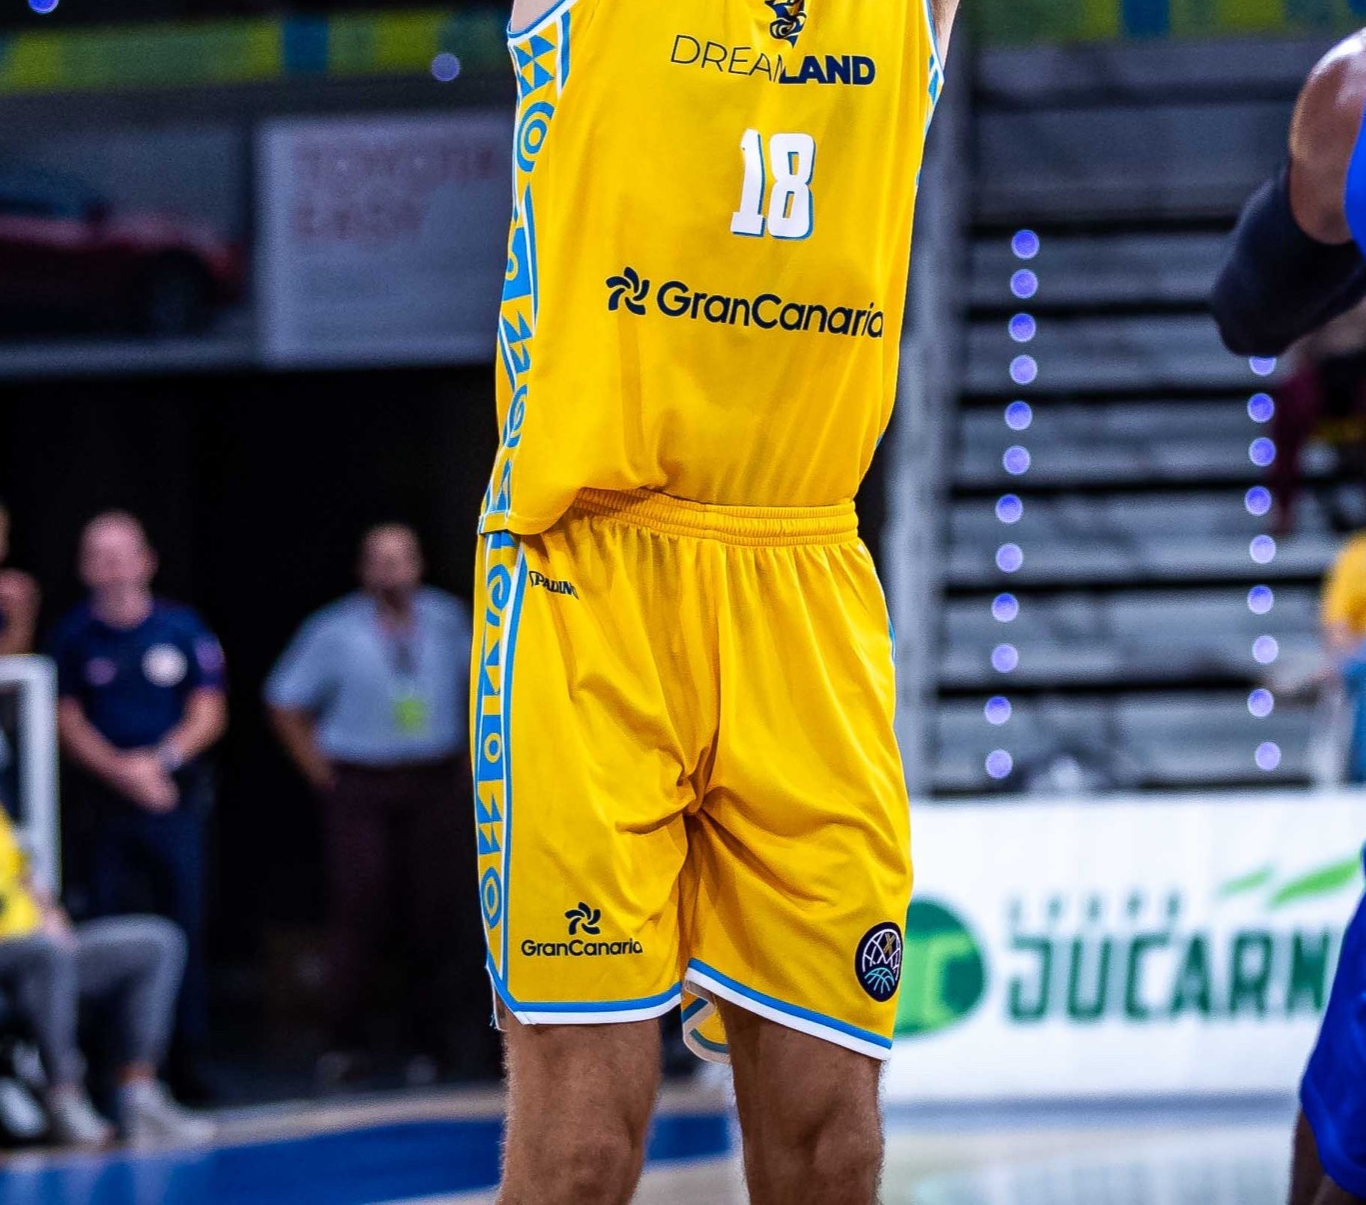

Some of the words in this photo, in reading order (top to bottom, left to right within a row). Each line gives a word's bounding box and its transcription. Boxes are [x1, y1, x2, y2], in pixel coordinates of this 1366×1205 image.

[731, 128, 816, 241] 18
[656, 281, 884, 339] GranCanaria
[521, 938, 644, 957] GranCanaria
